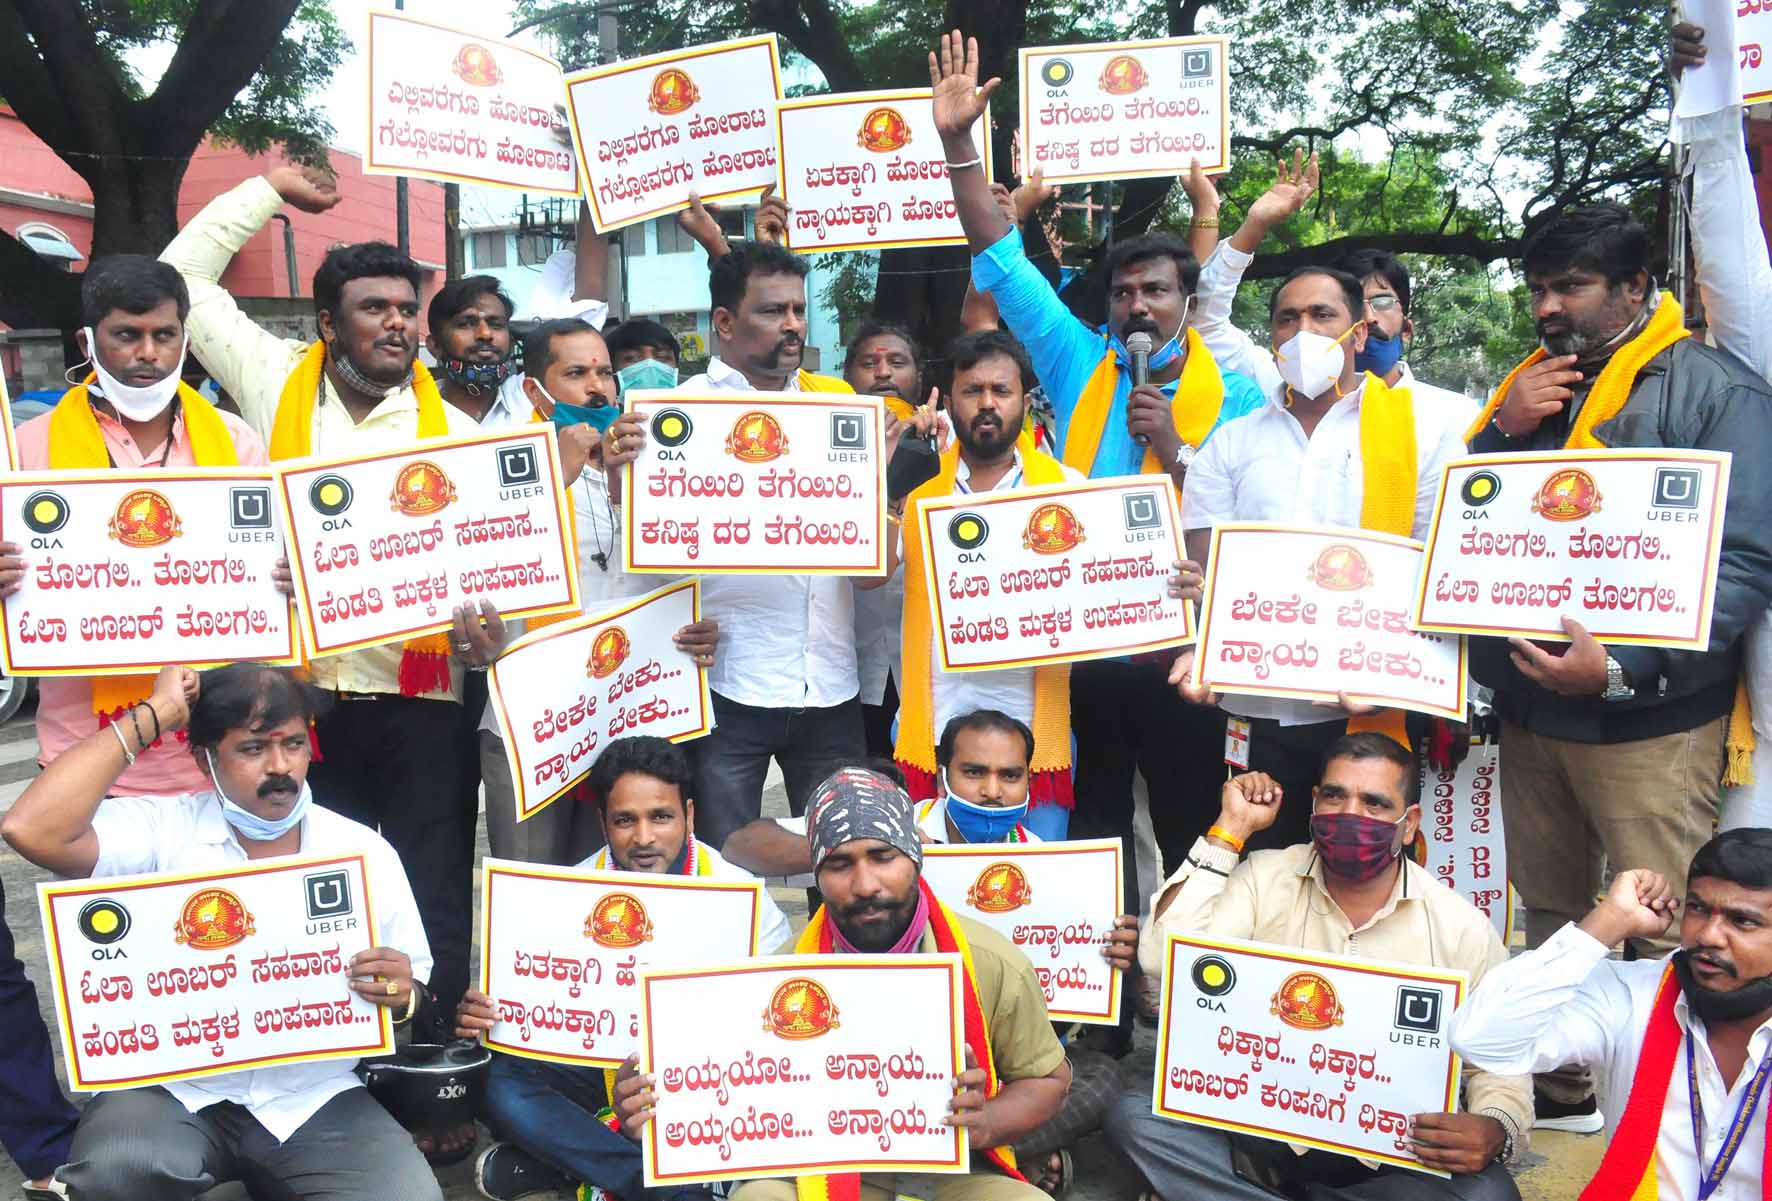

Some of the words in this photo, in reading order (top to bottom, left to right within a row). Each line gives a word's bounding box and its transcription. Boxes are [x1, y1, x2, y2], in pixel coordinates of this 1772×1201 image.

[388, 82, 478, 114] ಎಲ್ಲಿವರೆಗೂ
[1179, 79, 1215, 89] UBER
[1040, 103, 1113, 126] ತೆಗೆಯಿರಿ
[1124, 95, 1210, 120] ತೆಗೆಯಿರಿ..
[496, 136, 570, 172] ಹೋರಾಟ
[598, 125, 680, 166] ಎಲ್ಲಿವರೆಗೂ
[688, 109, 766, 139] ಹೋರಾಟ
[1036, 142, 1079, 169] ಕನಿಷ್ಠ
[1091, 139, 1118, 157] ದರ
[1131, 134, 1214, 154] ತೆಗೆಯಿರಿ..
[599, 161, 693, 204] ಗೆಲ್ಲೋವರೆಗು
[806, 151, 878, 197] ಏತಕ್ಕಾಗಿ
[796, 202, 892, 240] ನ್ಯಾಯಕ್ಕಾಗಿ
[902, 193, 958, 221] ಹೋರ
[658, 450, 685, 461] OLA
[828, 453, 868, 462] UBER
[500, 485, 543, 501] UBER
[648, 467, 744, 497] ತೆಗೆಯಿರಿ
[758, 467, 862, 498] ತೆಗೆಯಿರಿ..
[322, 518, 352, 531] OLA
[1463, 510, 1488, 519] OLA
[1648, 511, 1698, 522] UBER
[31, 538, 63, 549] OLA
[229, 532, 274, 543] UBER
[314, 541, 359, 573] ಓಲಾ
[370, 520, 444, 561] ಊಬರ್
[641, 518, 699, 560] ಕನಿಷ್ಠ
[713, 518, 751, 544] ದರ
[764, 515, 869, 545] ತೆಗೆಯಿರಿ..
[1125, 531, 1164, 543] UBER
[1460, 526, 1556, 558] ತೊಲಗಲಿ..
[1568, 527, 1670, 560] ತೊಲಗಲಿ..
[36, 556, 141, 590] ತೊಲಗಲಿ..
[153, 553, 256, 586] ತೊಲಗಲಿ..
[958, 552, 986, 563] OLA
[949, 571, 990, 600] ಓಲಾ
[1001, 558, 1071, 594] ಊಬರ್
[1436, 572, 1479, 603] ಓಲಾ
[1491, 577, 1572, 608] ಊಬರ್
[1583, 577, 1686, 613] ತೊಲಗಲಿ..
[318, 588, 383, 624] ಹೆಂಡತಿ
[392, 573, 448, 617] ಮಕ್ಕಳ
[1231, 592, 1316, 624] ಬೇಕೇ
[19, 611, 67, 644] ಓಲಾ
[80, 606, 164, 641] ಊಬರ್
[176, 604, 278, 637] ತೊಲಗಲಿ..
[950, 616, 1009, 645] ಹೆಂಡತಿ
[1019, 608, 1072, 648] ಮಕ್ಕಳ
[1220, 640, 1317, 680] ನ್ಯಾಯ
[1338, 643, 1445, 685] ಬೇಕು...
[533, 695, 597, 743] ಬೇಕೇ
[608, 659, 681, 704] ಬೇಕು...
[534, 730, 600, 786] ನ್ಯಾಯ
[608, 695, 689, 737] ಬೇಕು...
[306, 918, 356, 935] UBER
[91, 947, 128, 960] OLA
[80, 970, 133, 1004] ಓಲಾ
[147, 954, 237, 997] ಊಬರ್
[514, 950, 602, 999] ಏತಕ್ಕಾಗಿ
[1197, 997, 1226, 1013] OLA
[82, 1024, 159, 1057] ಹೆಂಡತಿ
[172, 1009, 240, 1057] ಮಕ್ಕಳ
[500, 998, 616, 1050] ನ್ಯಾಯಕ್ಕಾಗಿ
[1390, 1032, 1440, 1048] UBER
[1171, 1067, 1248, 1101] ಊಬರ್
[1261, 1081, 1347, 1124] ಕಂಪನಿಗೆ
[1359, 1104, 1408, 1150] ಧಿಕ್ಕಾ
